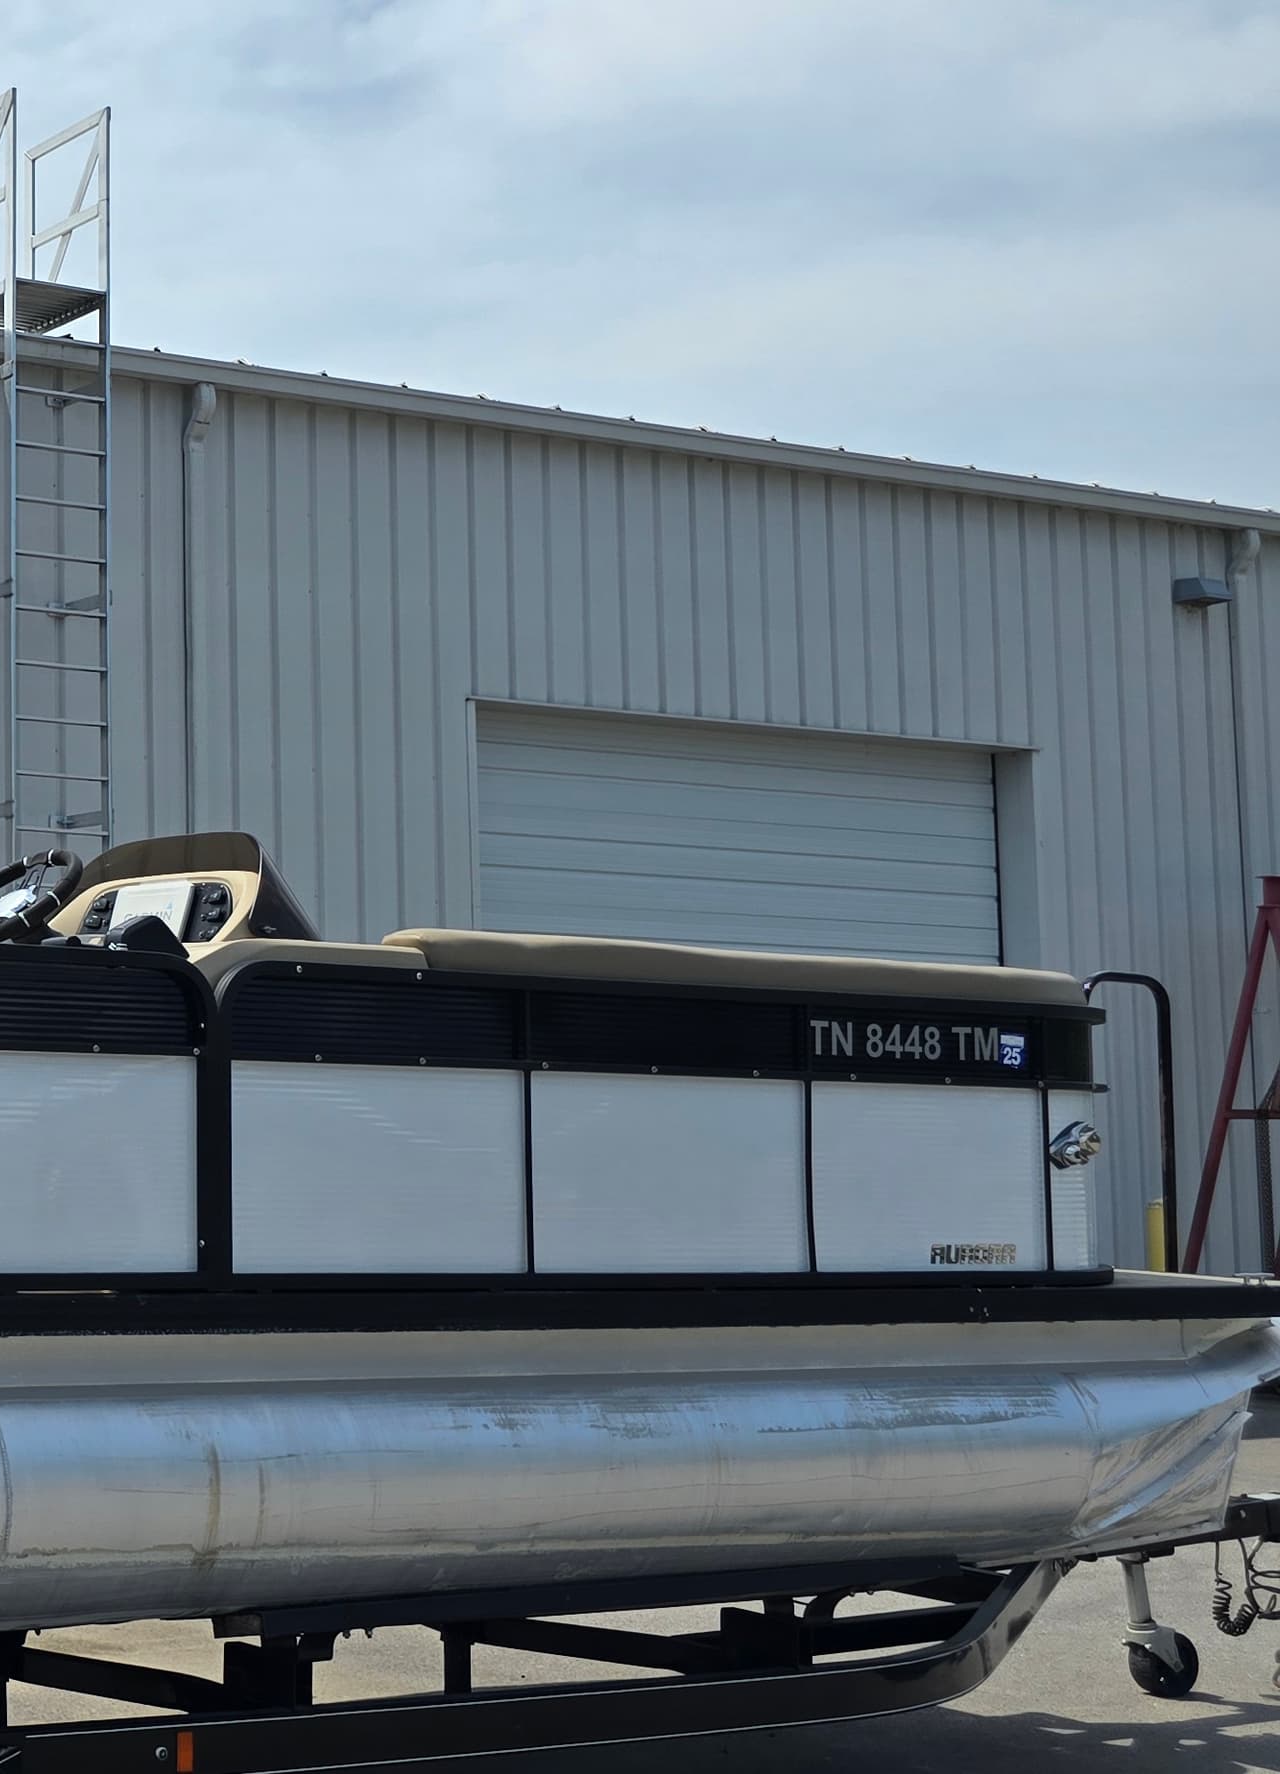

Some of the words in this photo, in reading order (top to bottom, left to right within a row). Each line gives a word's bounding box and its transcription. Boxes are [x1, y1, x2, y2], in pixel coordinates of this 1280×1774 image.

[810, 1020, 853, 1056] TN
[866, 1023, 941, 1060] 8448
[951, 1027, 999, 1061] TM
[1003, 1047, 1021, 1065] 25
